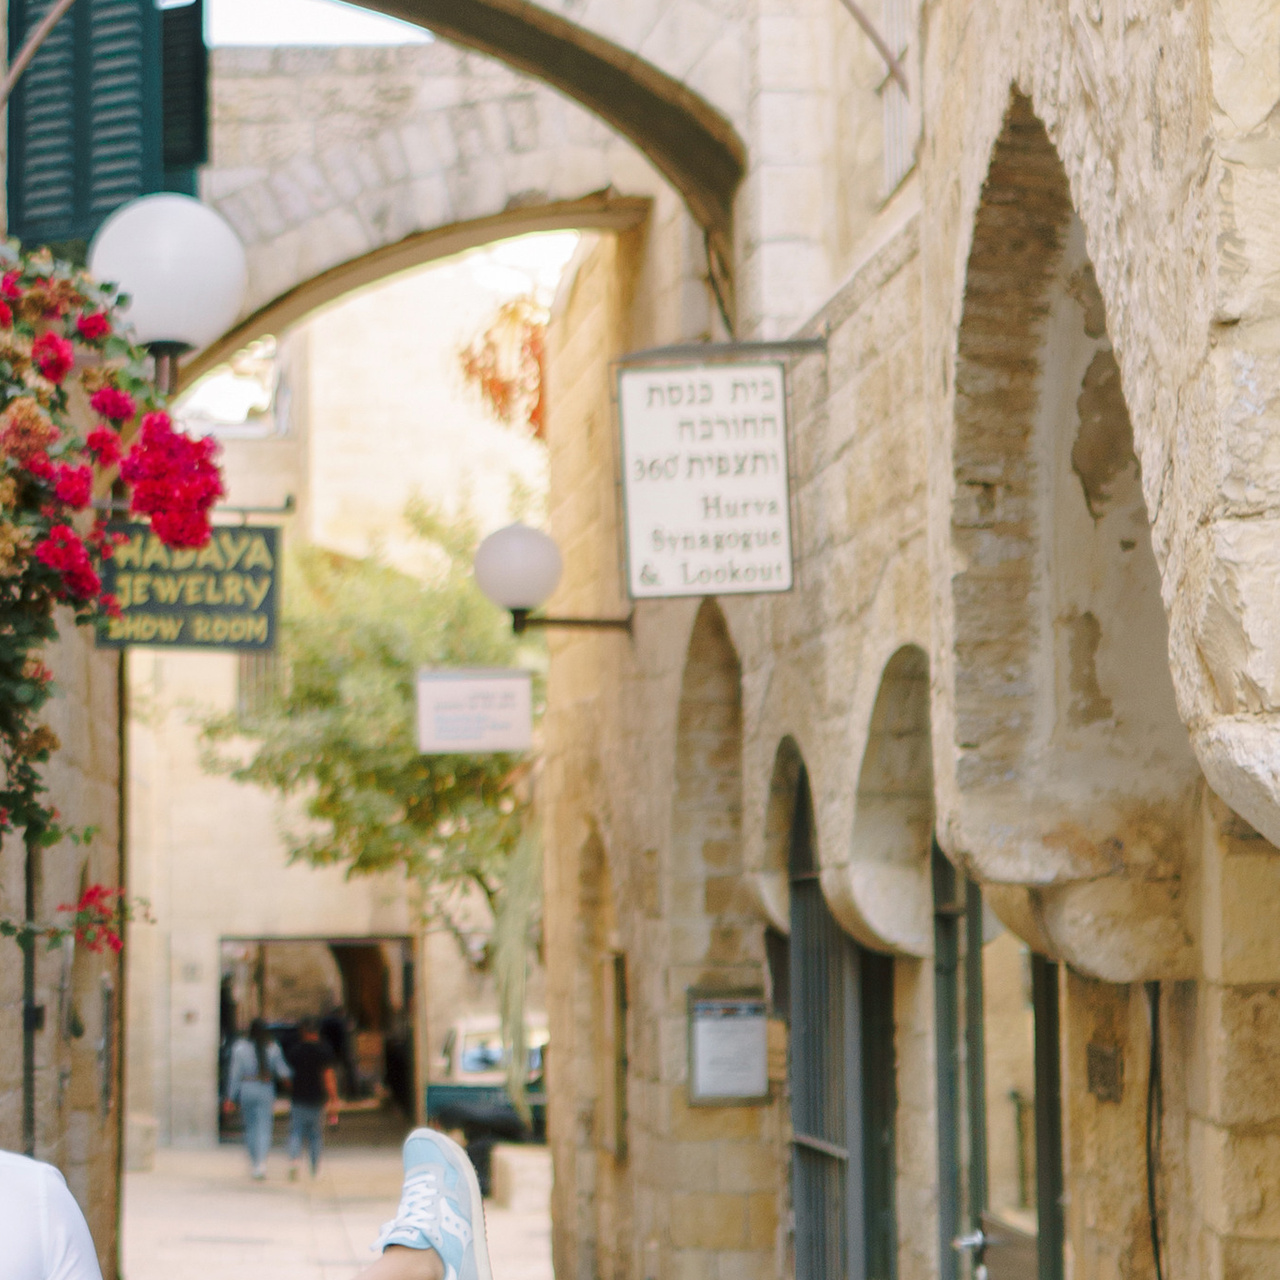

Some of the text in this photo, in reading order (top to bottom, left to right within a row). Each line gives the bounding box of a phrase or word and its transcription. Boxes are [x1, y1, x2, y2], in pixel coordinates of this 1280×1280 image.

[646, 376, 776, 407] בית כנסת
[686, 450, 779, 478] ותצפית
[702, 493, 779, 519] Hurva
[651, 527, 782, 554] Synagogue
[639, 560, 783, 586] & Lookout
[115, 572, 271, 610] JEWELRY
[108, 613, 268, 643] SHOW ROOM
